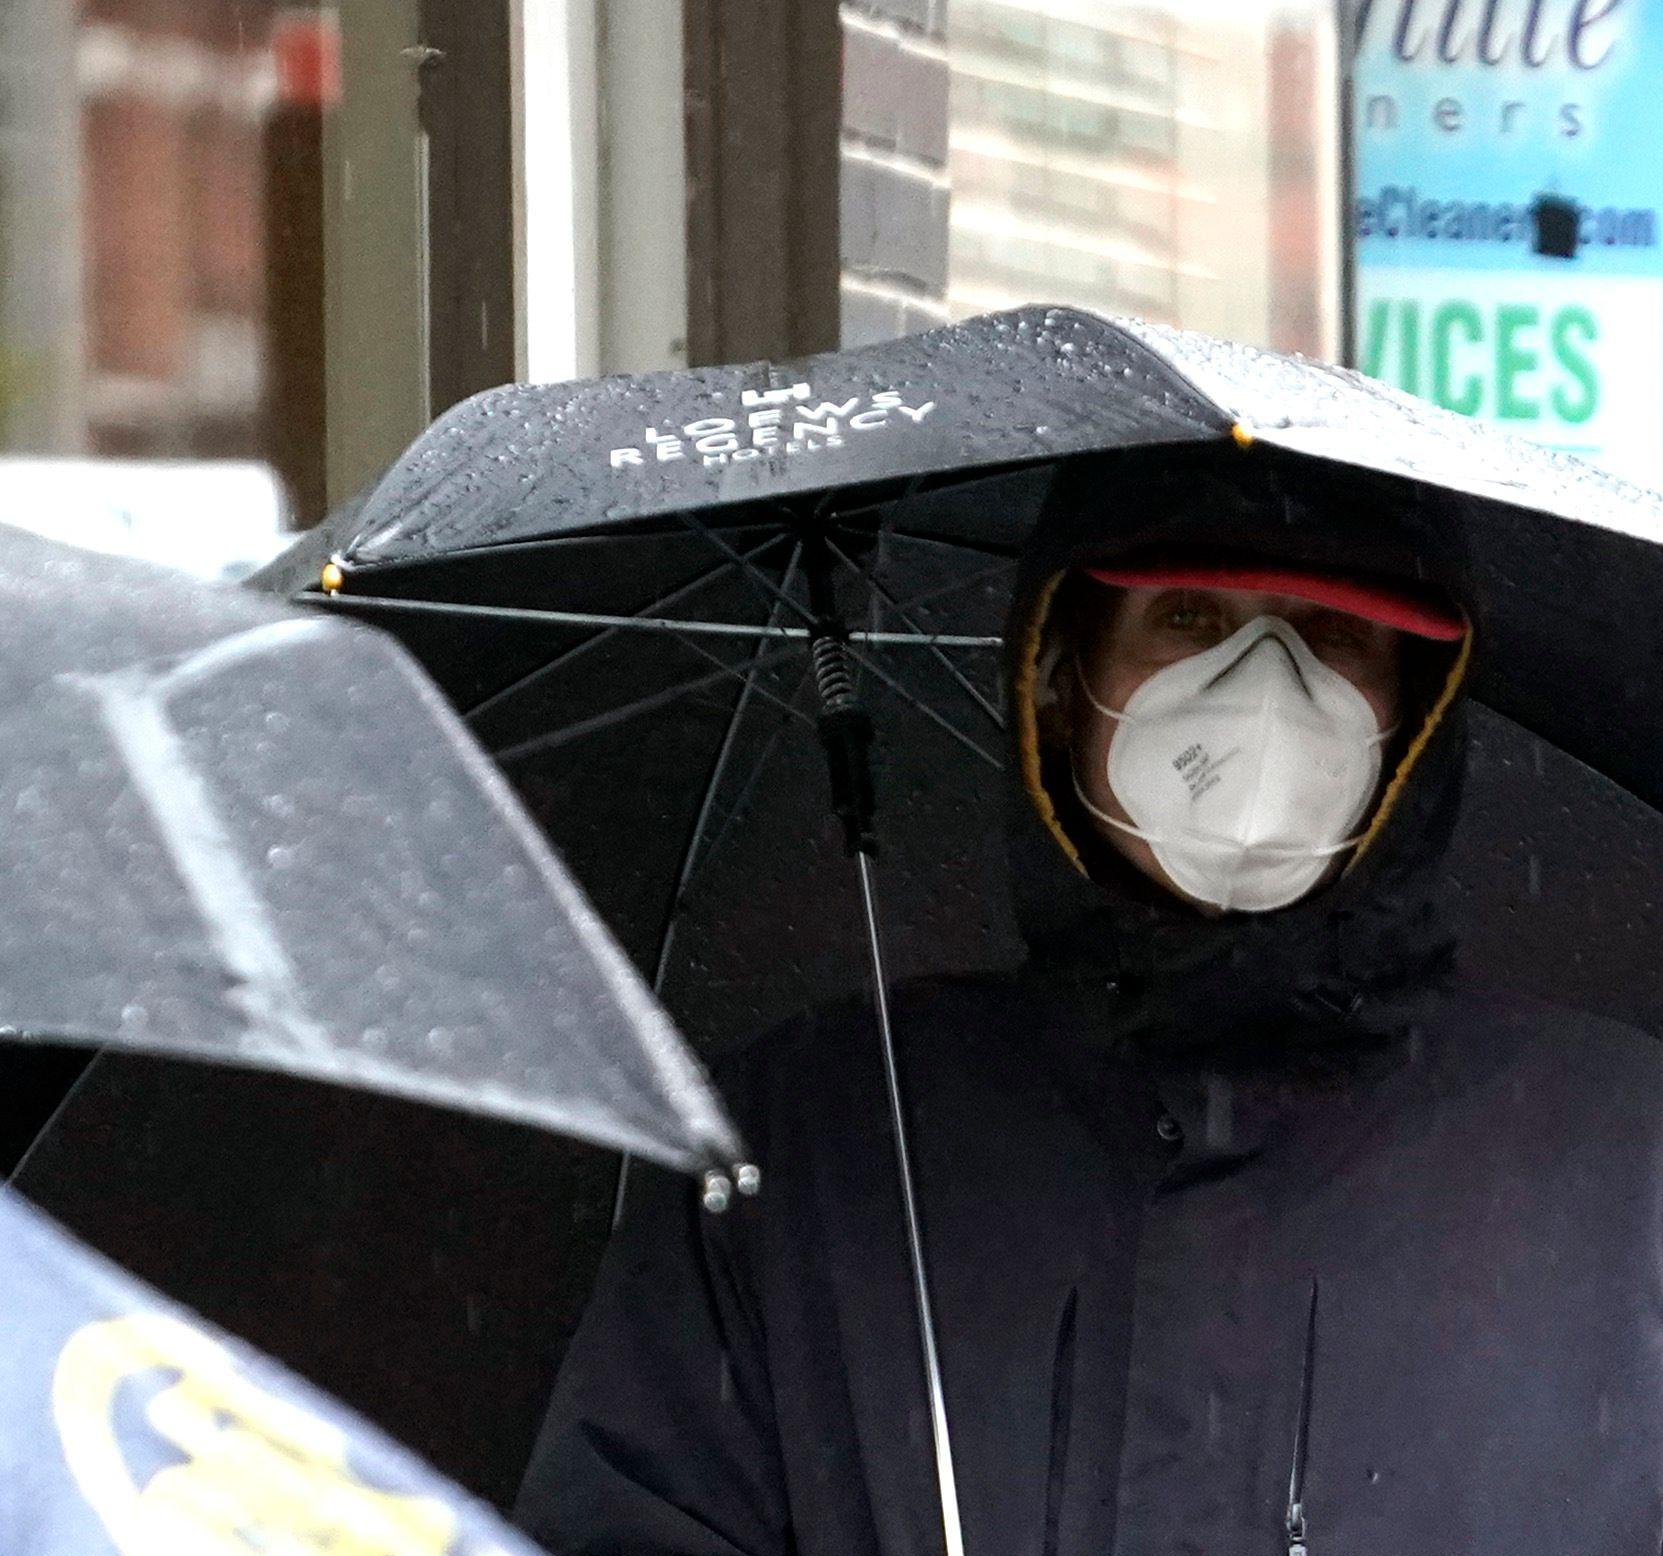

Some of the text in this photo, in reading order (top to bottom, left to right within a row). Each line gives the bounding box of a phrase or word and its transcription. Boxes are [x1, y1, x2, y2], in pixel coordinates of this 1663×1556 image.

[1358, 186, 1655, 246] eCleanercom
[610, 401, 935, 468] REGENCY
[645, 390, 903, 444] LOEWS
[702, 433, 846, 468] HOTELS
